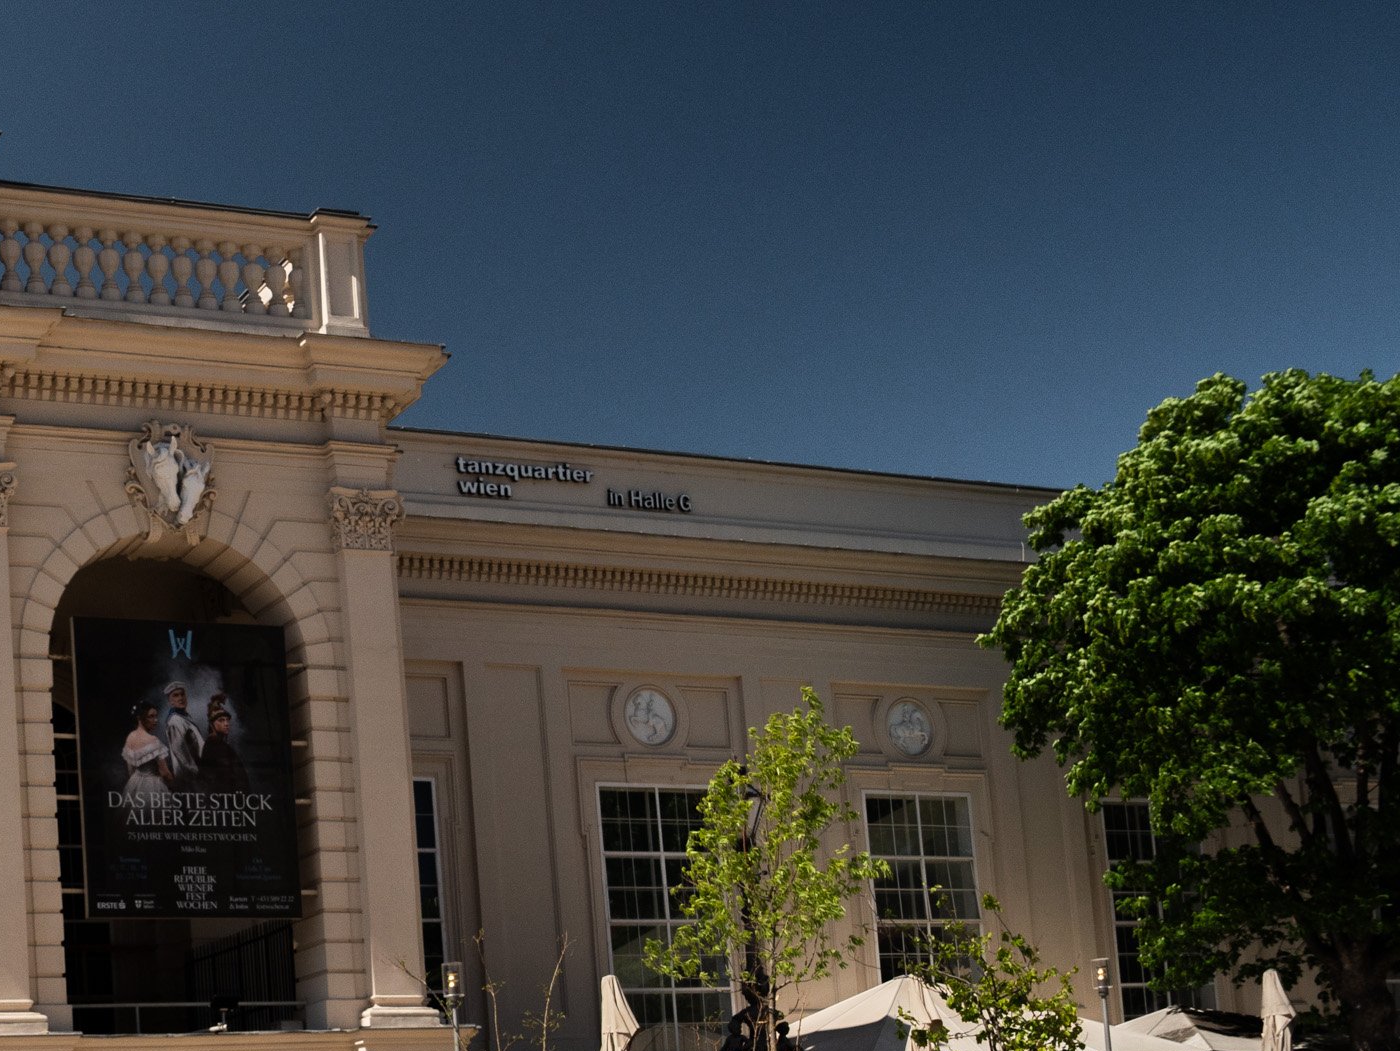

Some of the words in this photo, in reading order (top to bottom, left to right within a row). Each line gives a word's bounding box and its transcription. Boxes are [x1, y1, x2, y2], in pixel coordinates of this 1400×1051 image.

[456, 456, 594, 483] tanzquartier
[458, 477, 512, 497] wien
[607, 489, 624, 506] in
[629, 490, 675, 510] Halle
[678, 494, 691, 512] G
[108, 791, 146, 809] DAS
[149, 792, 206, 810] BESTE
[209, 791, 272, 811] STÜCK
[126, 810, 185, 825] ALLER
[188, 810, 257, 827] ZEITEN
[137, 832, 165, 841] JAHRE
[165, 832, 200, 841] WIENER
[200, 833, 257, 842] FESTWOCHEN
[183, 866, 207, 875] FREIE
[174, 875, 217, 884] REPUBLIK
[178, 884, 213, 893] WIENER
[186, 892, 207, 901] FEST
[176, 901, 218, 910] WOCHEN
